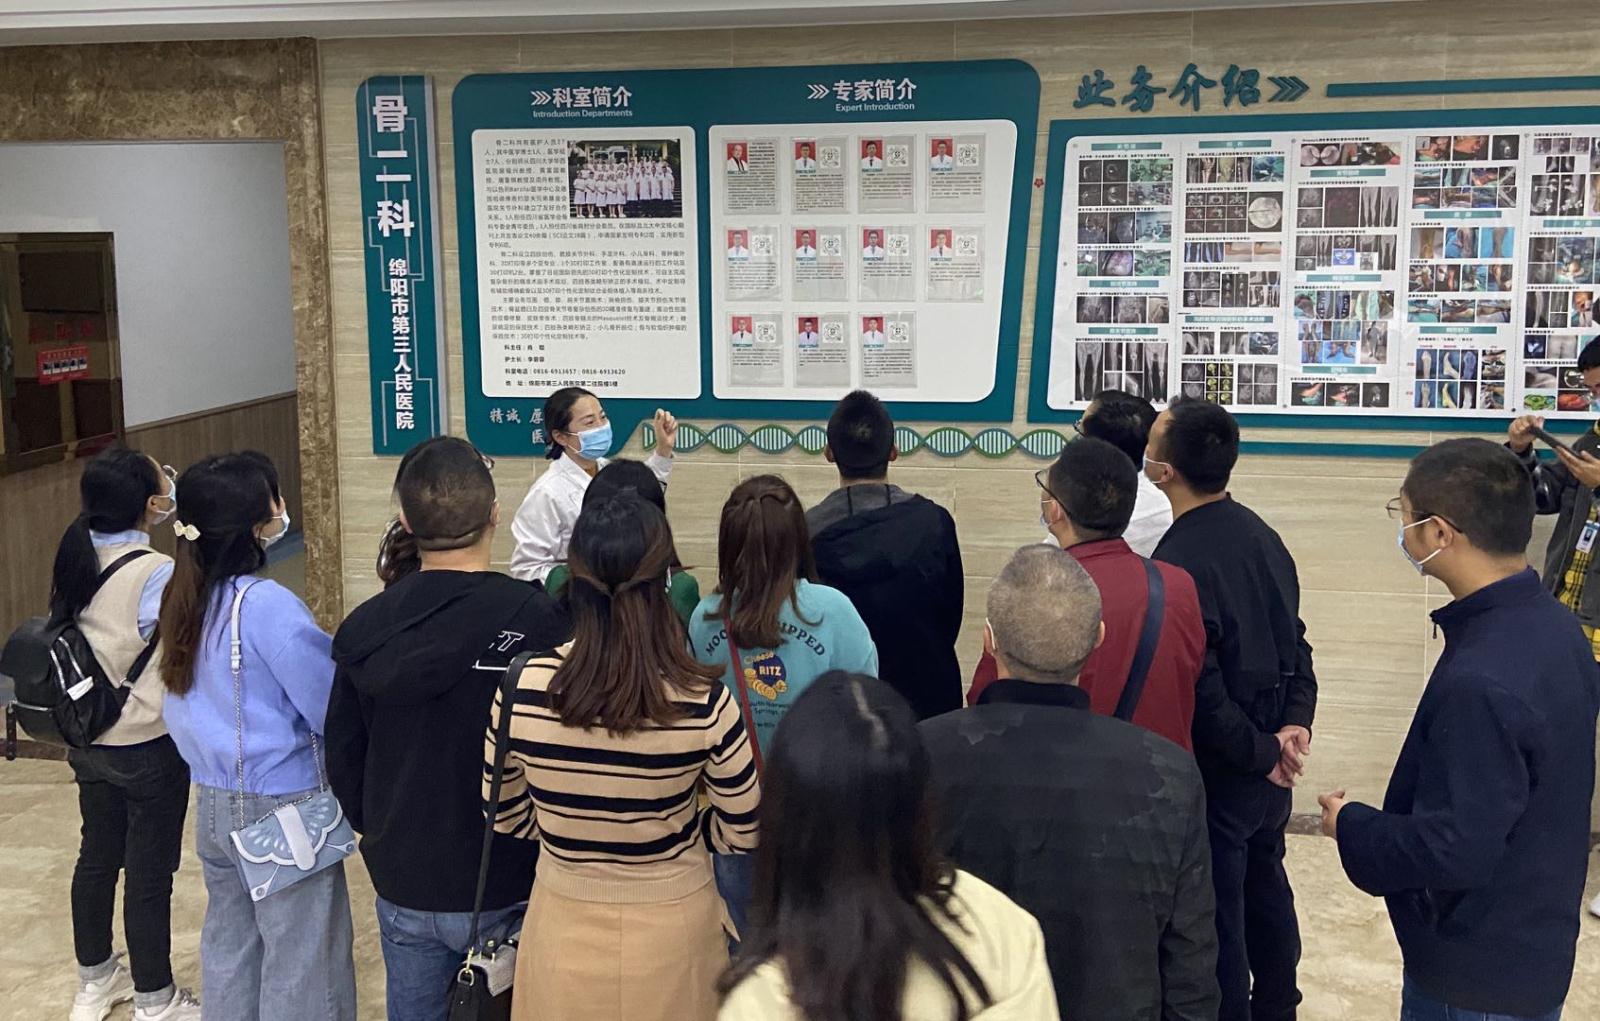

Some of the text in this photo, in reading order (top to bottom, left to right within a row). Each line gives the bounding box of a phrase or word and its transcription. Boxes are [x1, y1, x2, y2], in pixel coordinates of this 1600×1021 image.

[552, 85, 632, 109] 科室简介
[832, 77, 917, 101] 专家简介
[1073, 63, 1261, 113] 业务介绍
[533, 109, 633, 118] Introduction Departments
[835, 102, 915, 112] Expert Introduction
[372, 94, 415, 238] 骨二科
[388, 258, 415, 430] 绵阳市第三人民医院
[489, 407, 521, 424] 精诚
[759, 665, 782, 676] RITZ
